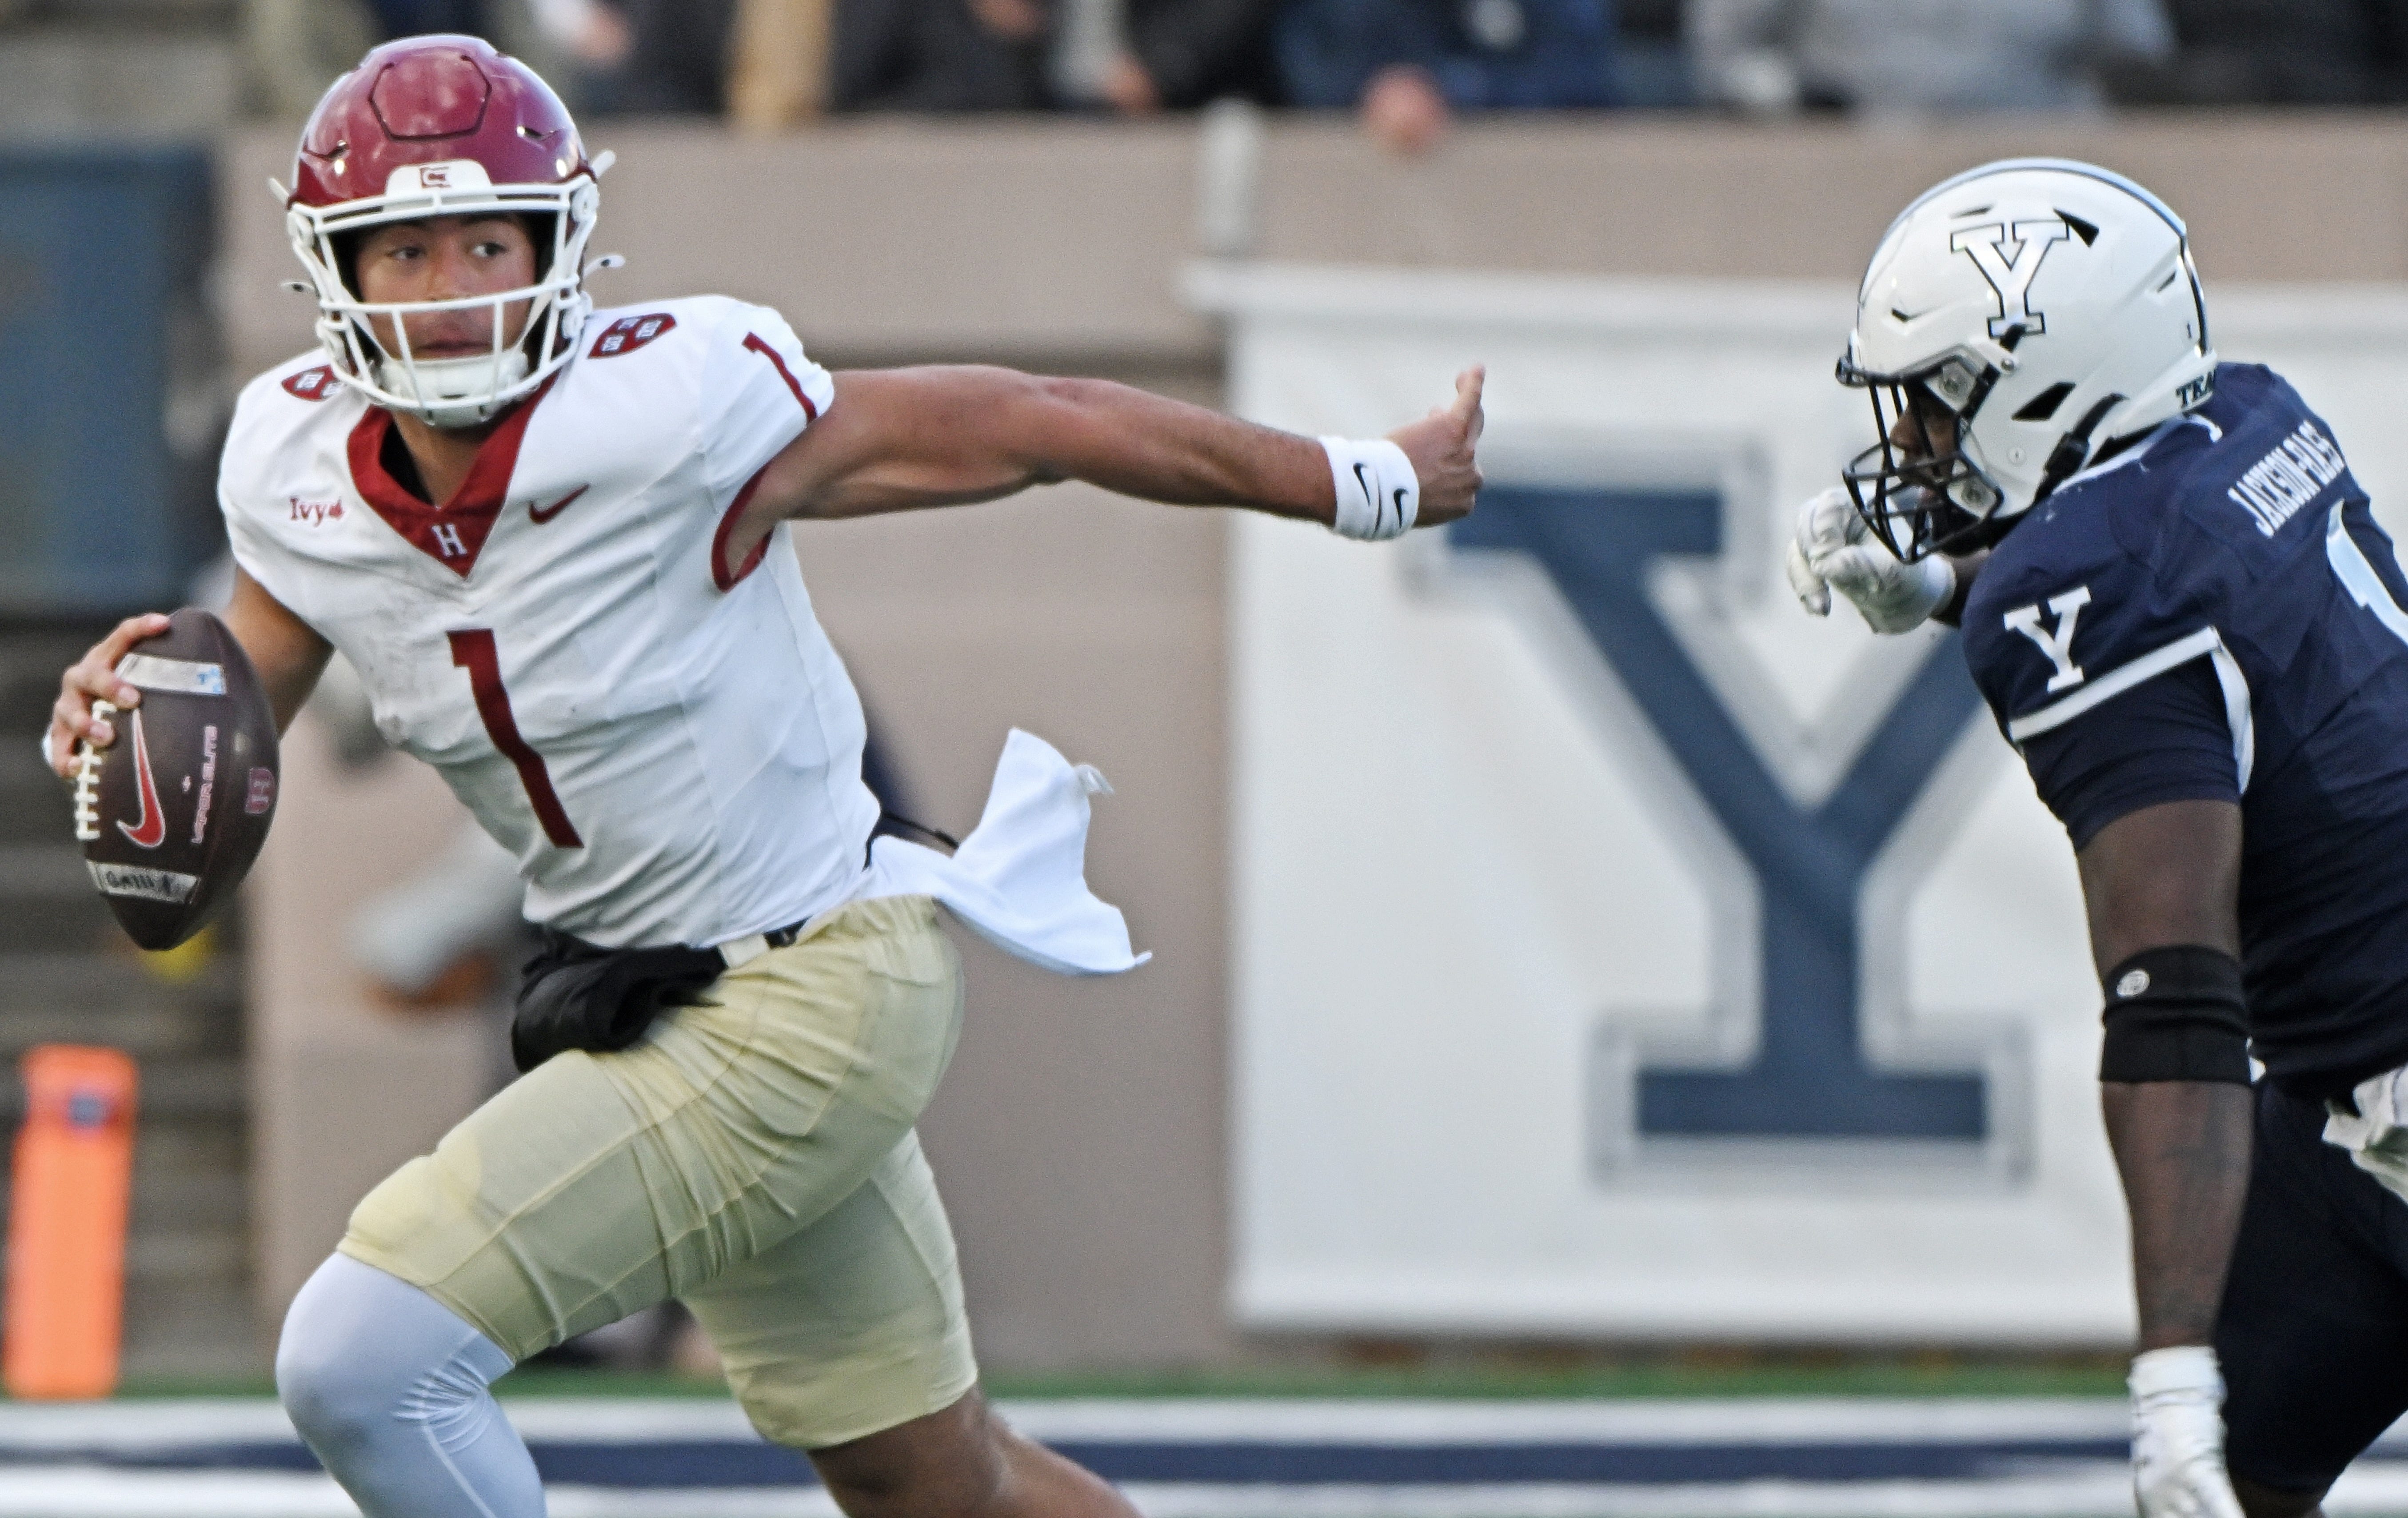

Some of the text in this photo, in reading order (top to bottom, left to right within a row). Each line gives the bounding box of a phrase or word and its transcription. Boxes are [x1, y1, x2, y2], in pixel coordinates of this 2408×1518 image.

[1950, 219, 2070, 338] Y
[742, 331, 817, 422] 1
[289, 497, 326, 527] Ivy
[431, 523, 467, 557] H
[2003, 584, 2093, 693] Y
[446, 628, 585, 849] 1
[1438, 478, 1995, 1146] Y
